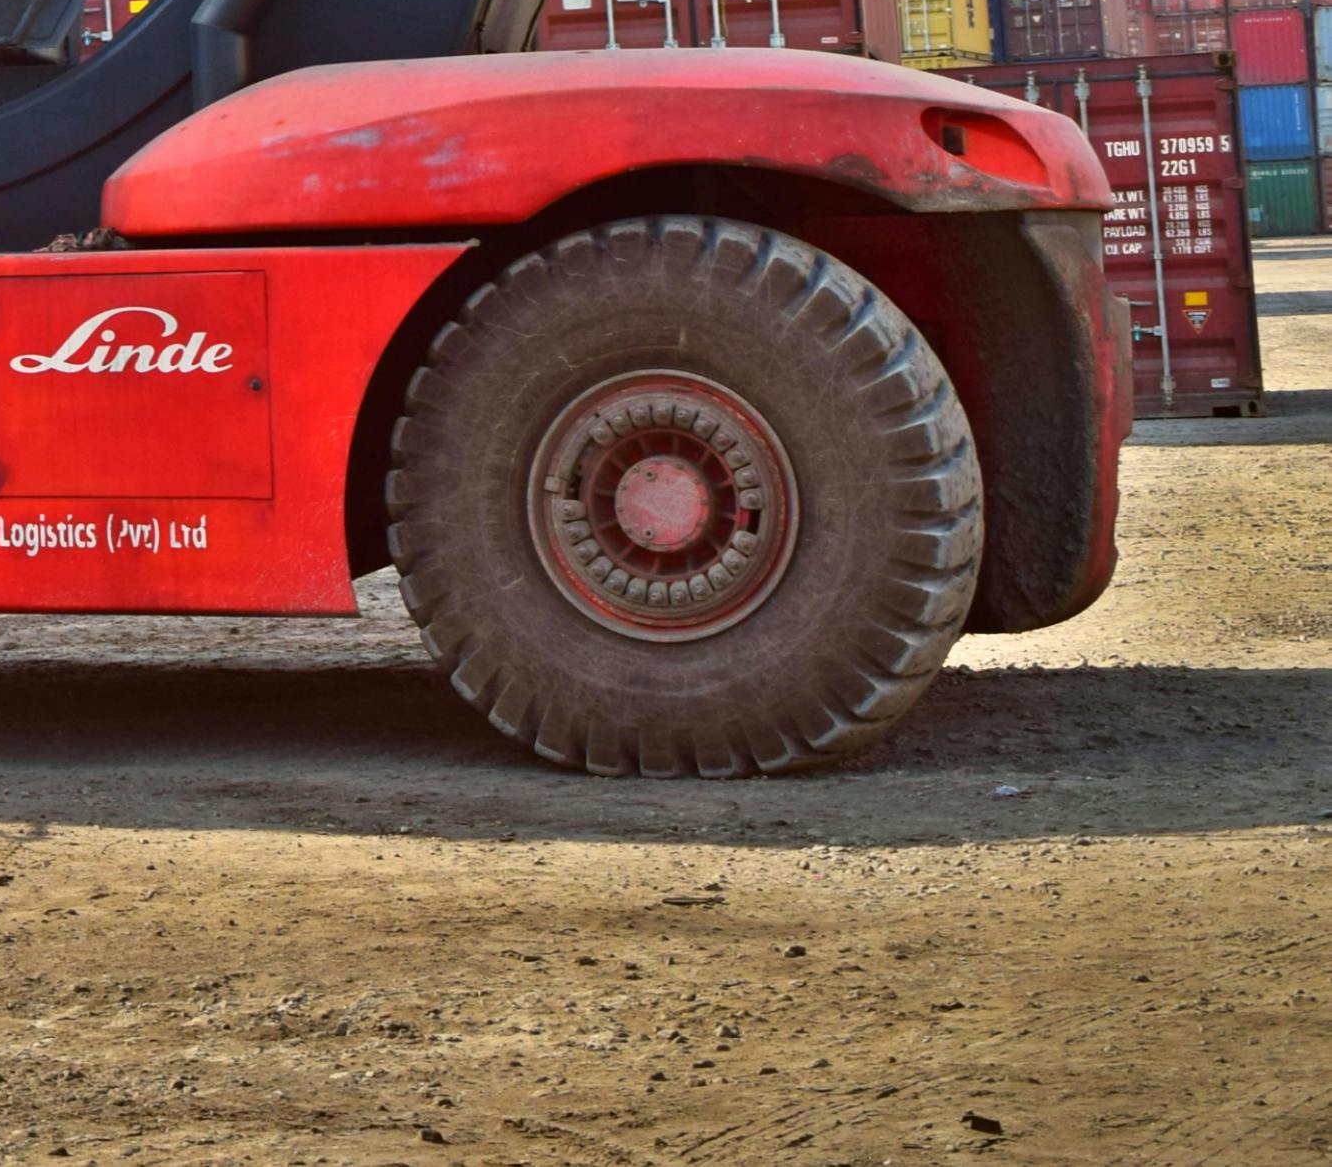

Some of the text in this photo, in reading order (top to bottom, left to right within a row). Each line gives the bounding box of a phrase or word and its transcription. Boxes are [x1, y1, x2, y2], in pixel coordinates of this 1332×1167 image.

[1105, 135, 1230, 157] TGHU 370959 5
[1161, 159, 1196, 176] 22G1
[1111, 192, 1127, 203] AX.
[1104, 226, 1146, 238] PAYLOAD
[9, 306, 233, 374] Linde
[170, 515, 207, 549] Ltd
